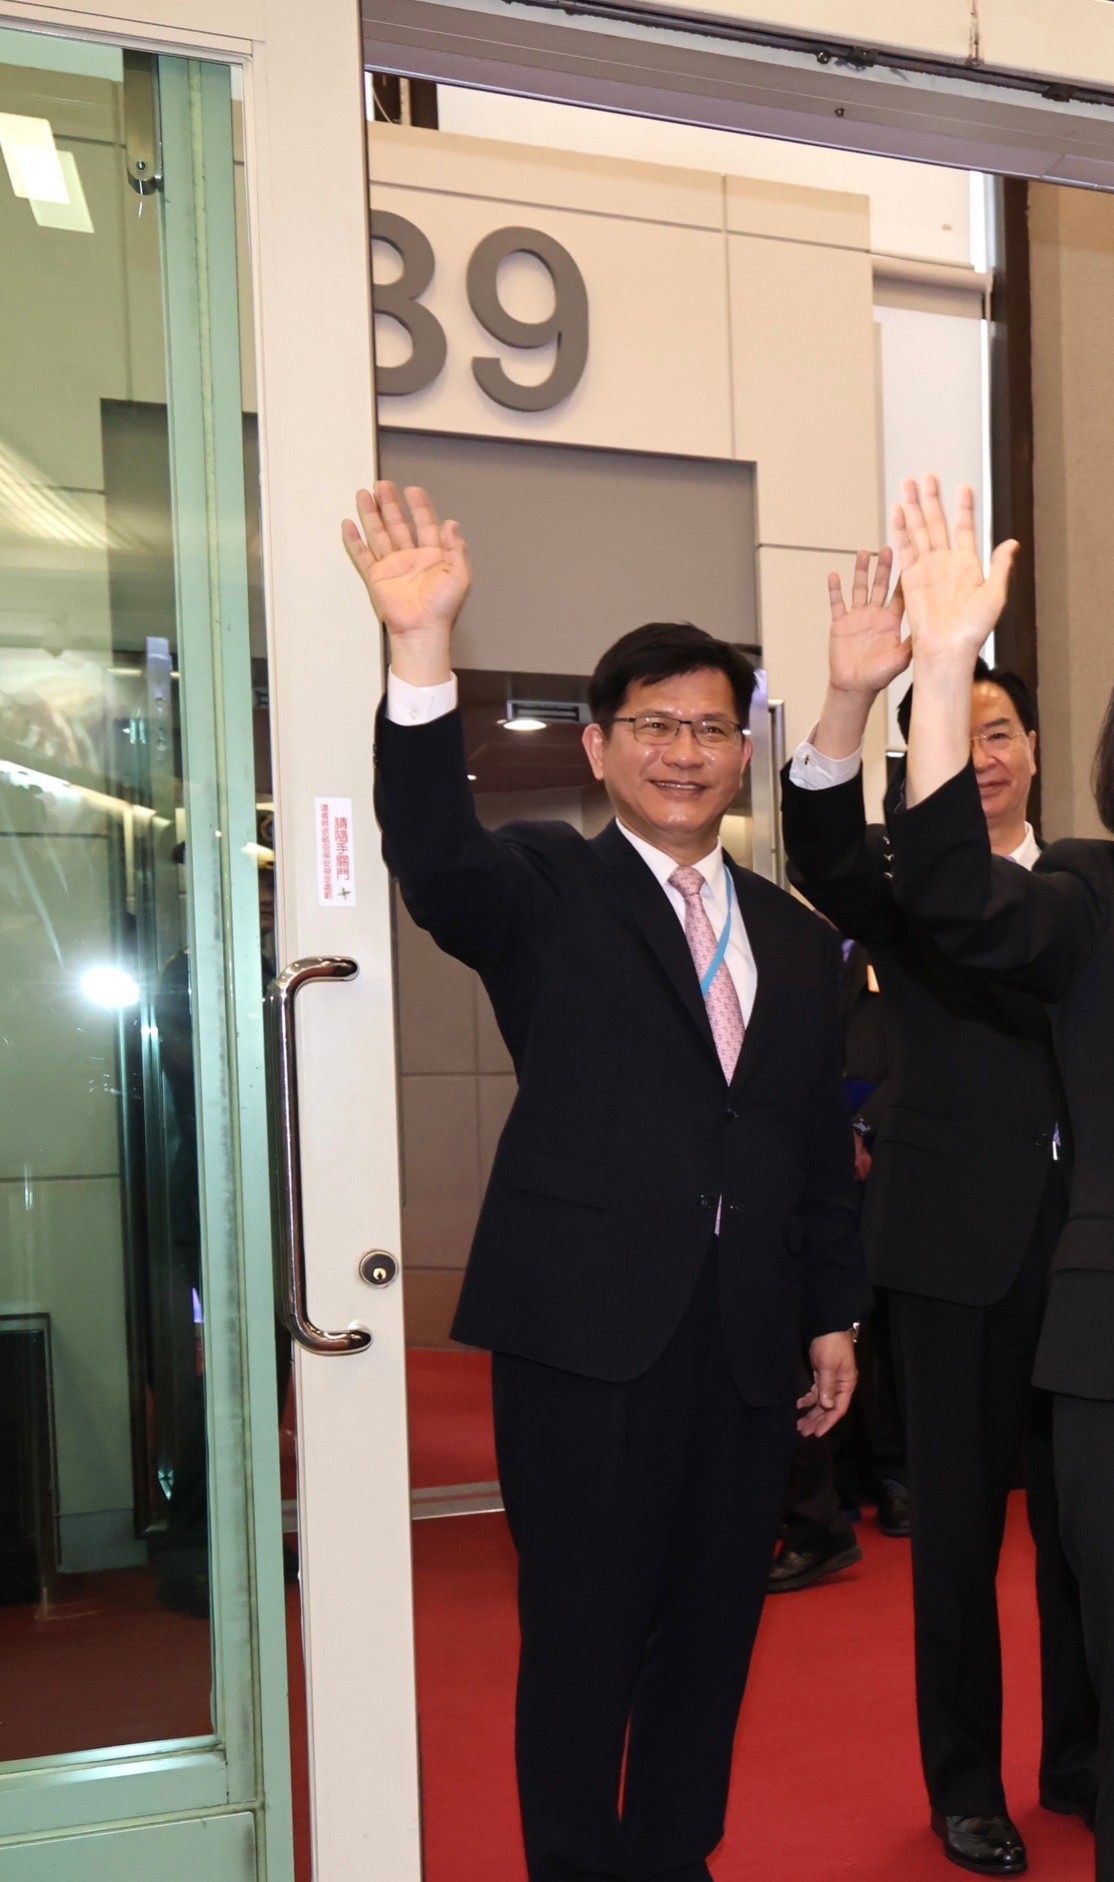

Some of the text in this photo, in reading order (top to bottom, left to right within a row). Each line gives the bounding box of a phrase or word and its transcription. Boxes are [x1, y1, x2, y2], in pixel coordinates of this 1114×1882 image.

[335, 817, 350, 881] 請隨手關門
